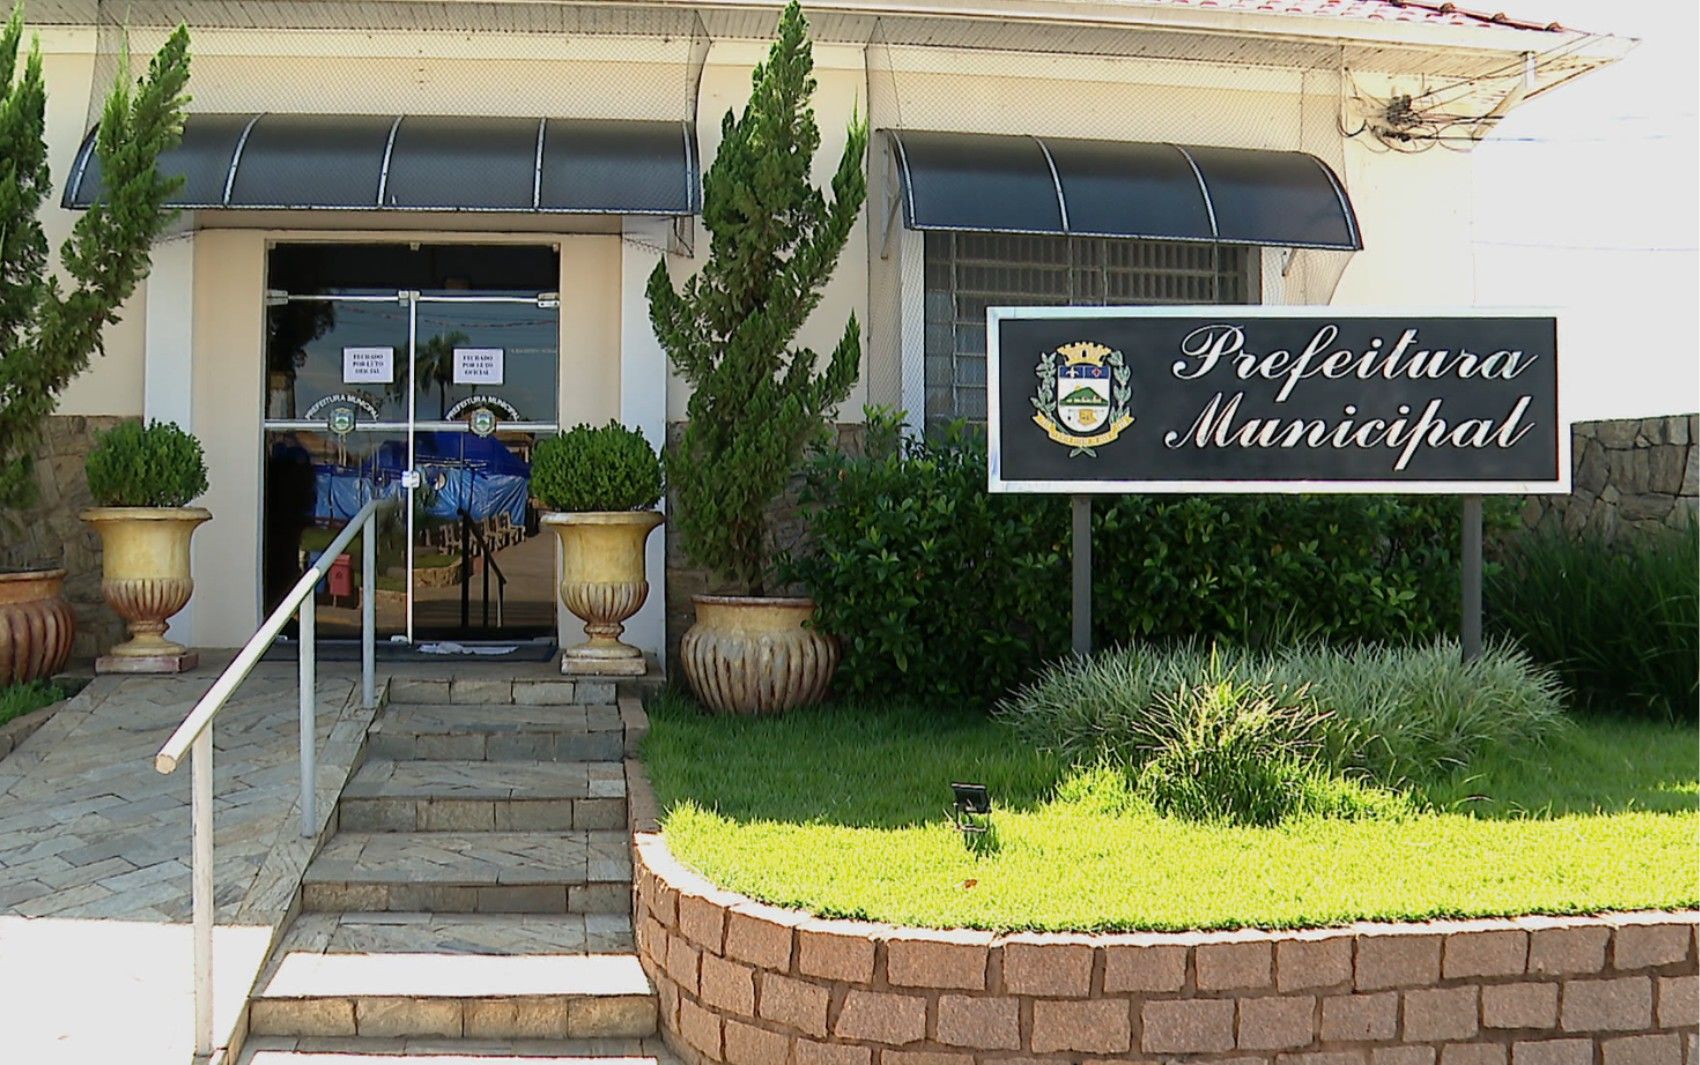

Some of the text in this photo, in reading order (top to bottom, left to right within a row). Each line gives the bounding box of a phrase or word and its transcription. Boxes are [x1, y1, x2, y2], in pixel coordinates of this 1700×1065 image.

[1172, 324, 1539, 402] Prefeitura
[304, 394, 346, 421] PREFEITURA
[445, 395, 487, 422] PREFEITURA
[1164, 391, 1536, 472] Municipal
